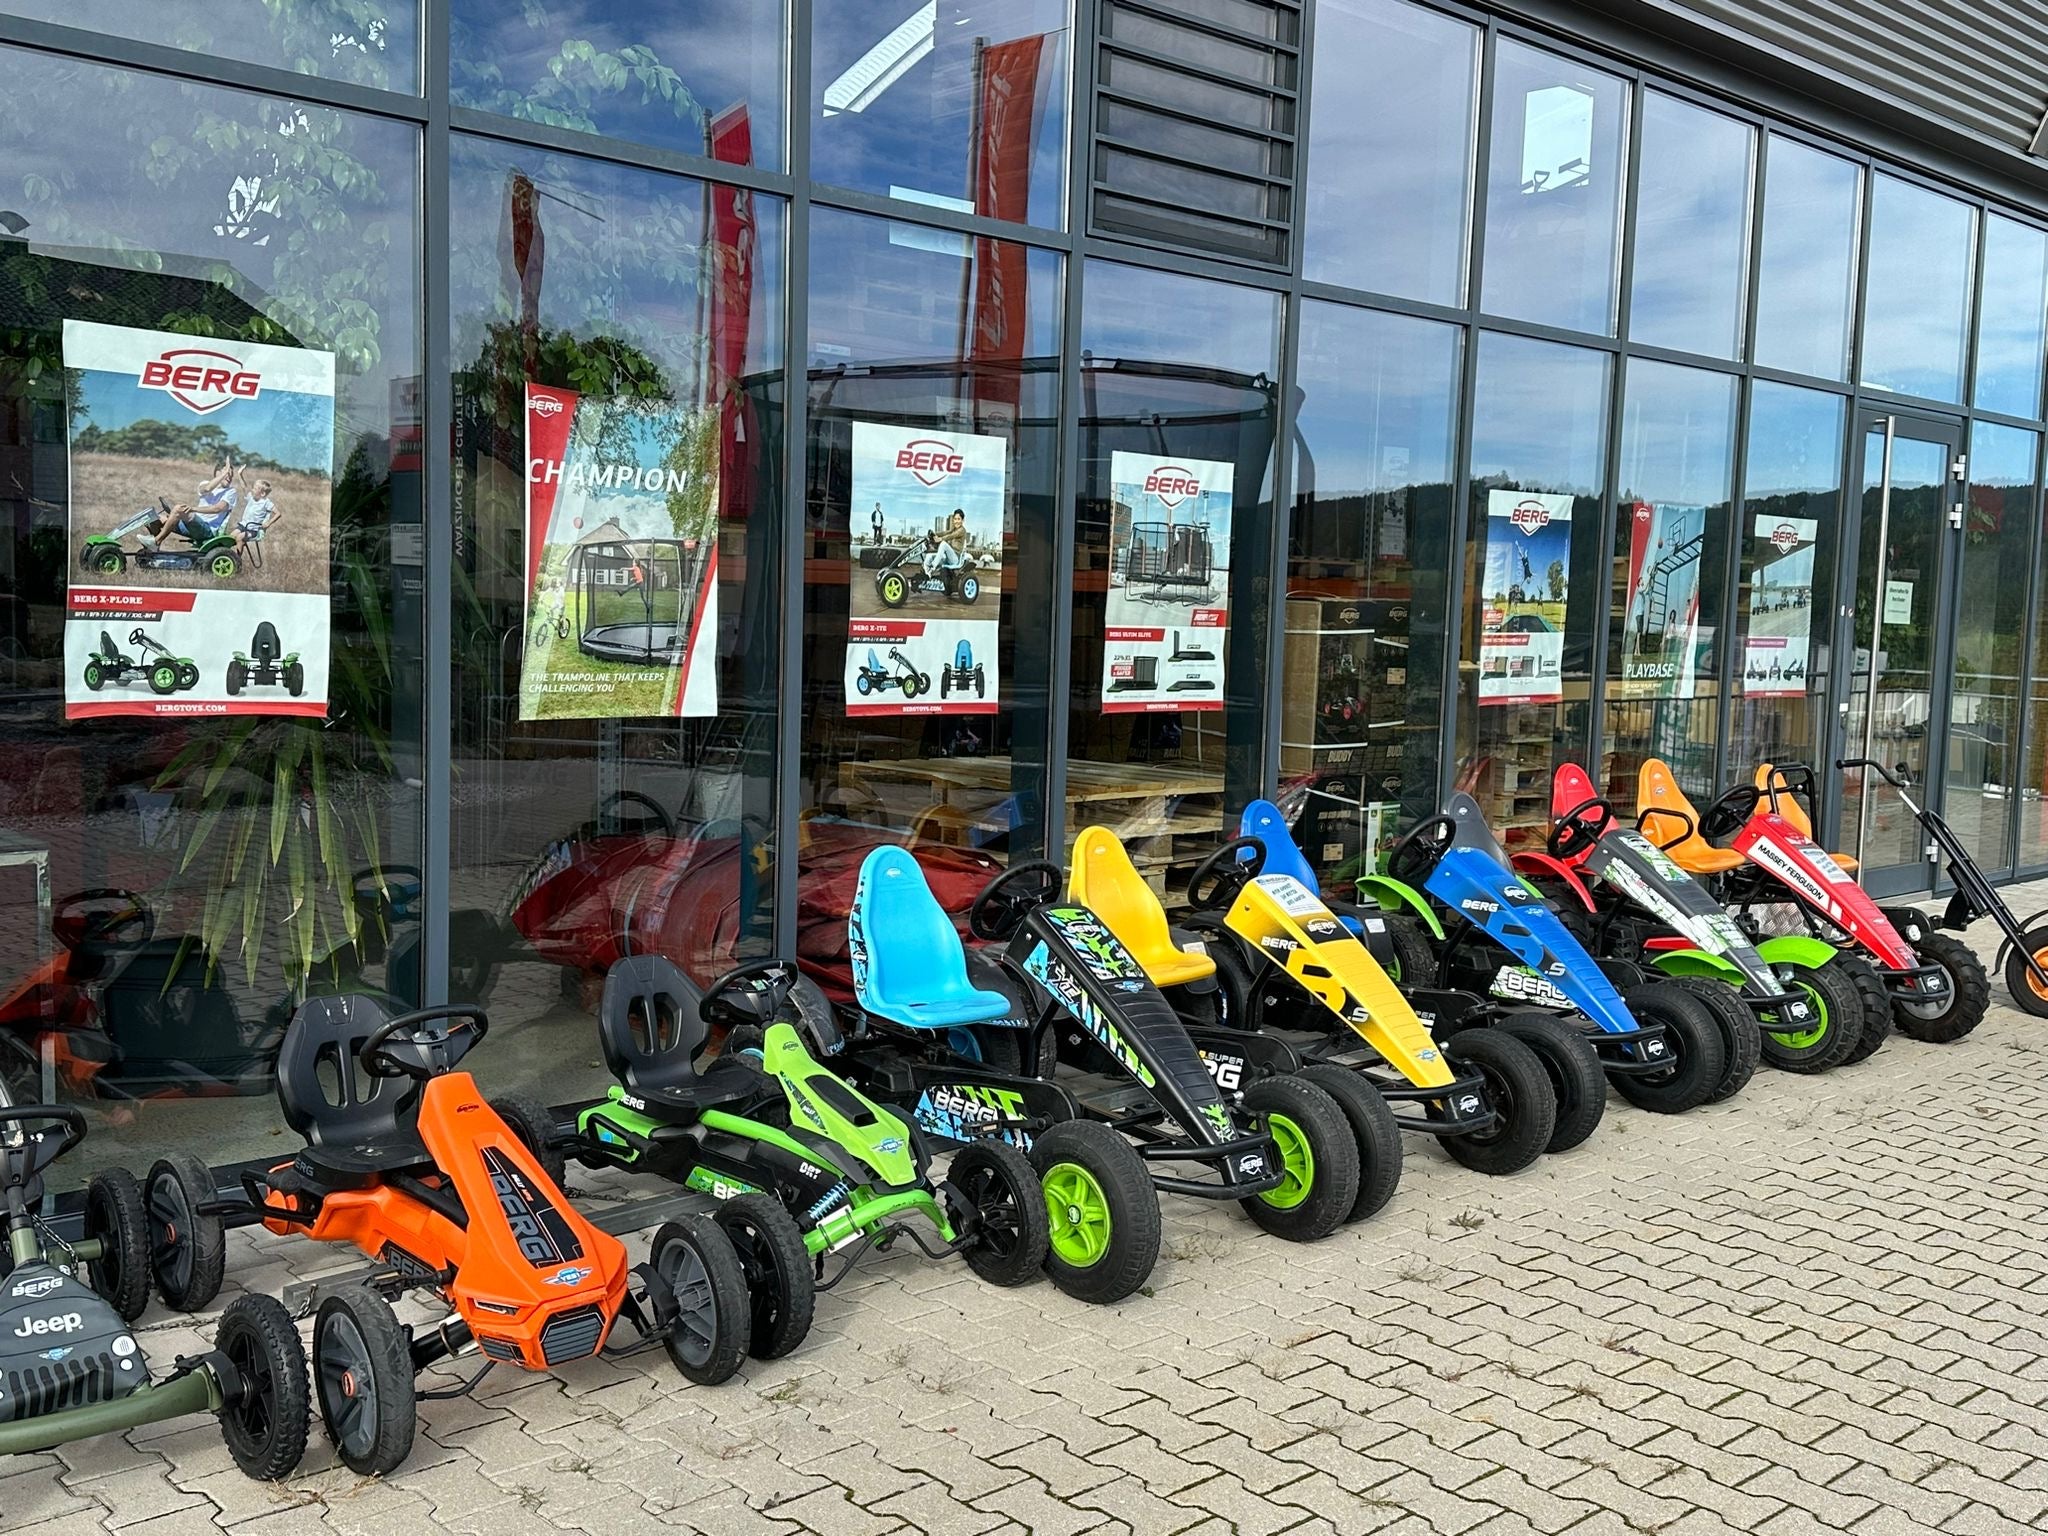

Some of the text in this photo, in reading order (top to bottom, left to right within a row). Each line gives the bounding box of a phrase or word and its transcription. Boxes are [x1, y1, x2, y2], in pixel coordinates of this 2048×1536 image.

[142, 362, 261, 396] BERG
[528, 399, 564, 413] BERG
[896, 450, 964, 473] BERG
[529, 458, 688, 493] CHAMPION
[1144, 475, 1200, 496] BERG
[1512, 508, 1550, 524] BERG
[1771, 530, 1799, 544] BERG
[74, 595, 143, 604] BERG X-PLORE
[530, 672, 665, 683] THE TRAMPOLINE THAT KEEPS
[1626, 663, 1675, 678] PLAYBASE
[529, 683, 616, 693] CHALLENGING YOU
[155, 704, 226, 712] BERGTOYS.COM
[1328, 749, 1353, 763] BUDDY
[1757, 844, 1824, 900] MASSEY FERGUSON
[1461, 899, 1499, 913] BERG
[1066, 924, 1101, 934] BERG
[1307, 921, 1337, 932] BERG
[1261, 935, 1298, 952] BERG
[933, 1090, 995, 1121] BERG
[295, 1157, 314, 1177] ERG
[799, 1161, 822, 1180] DRT
[12, 1276, 64, 1297] BERG
